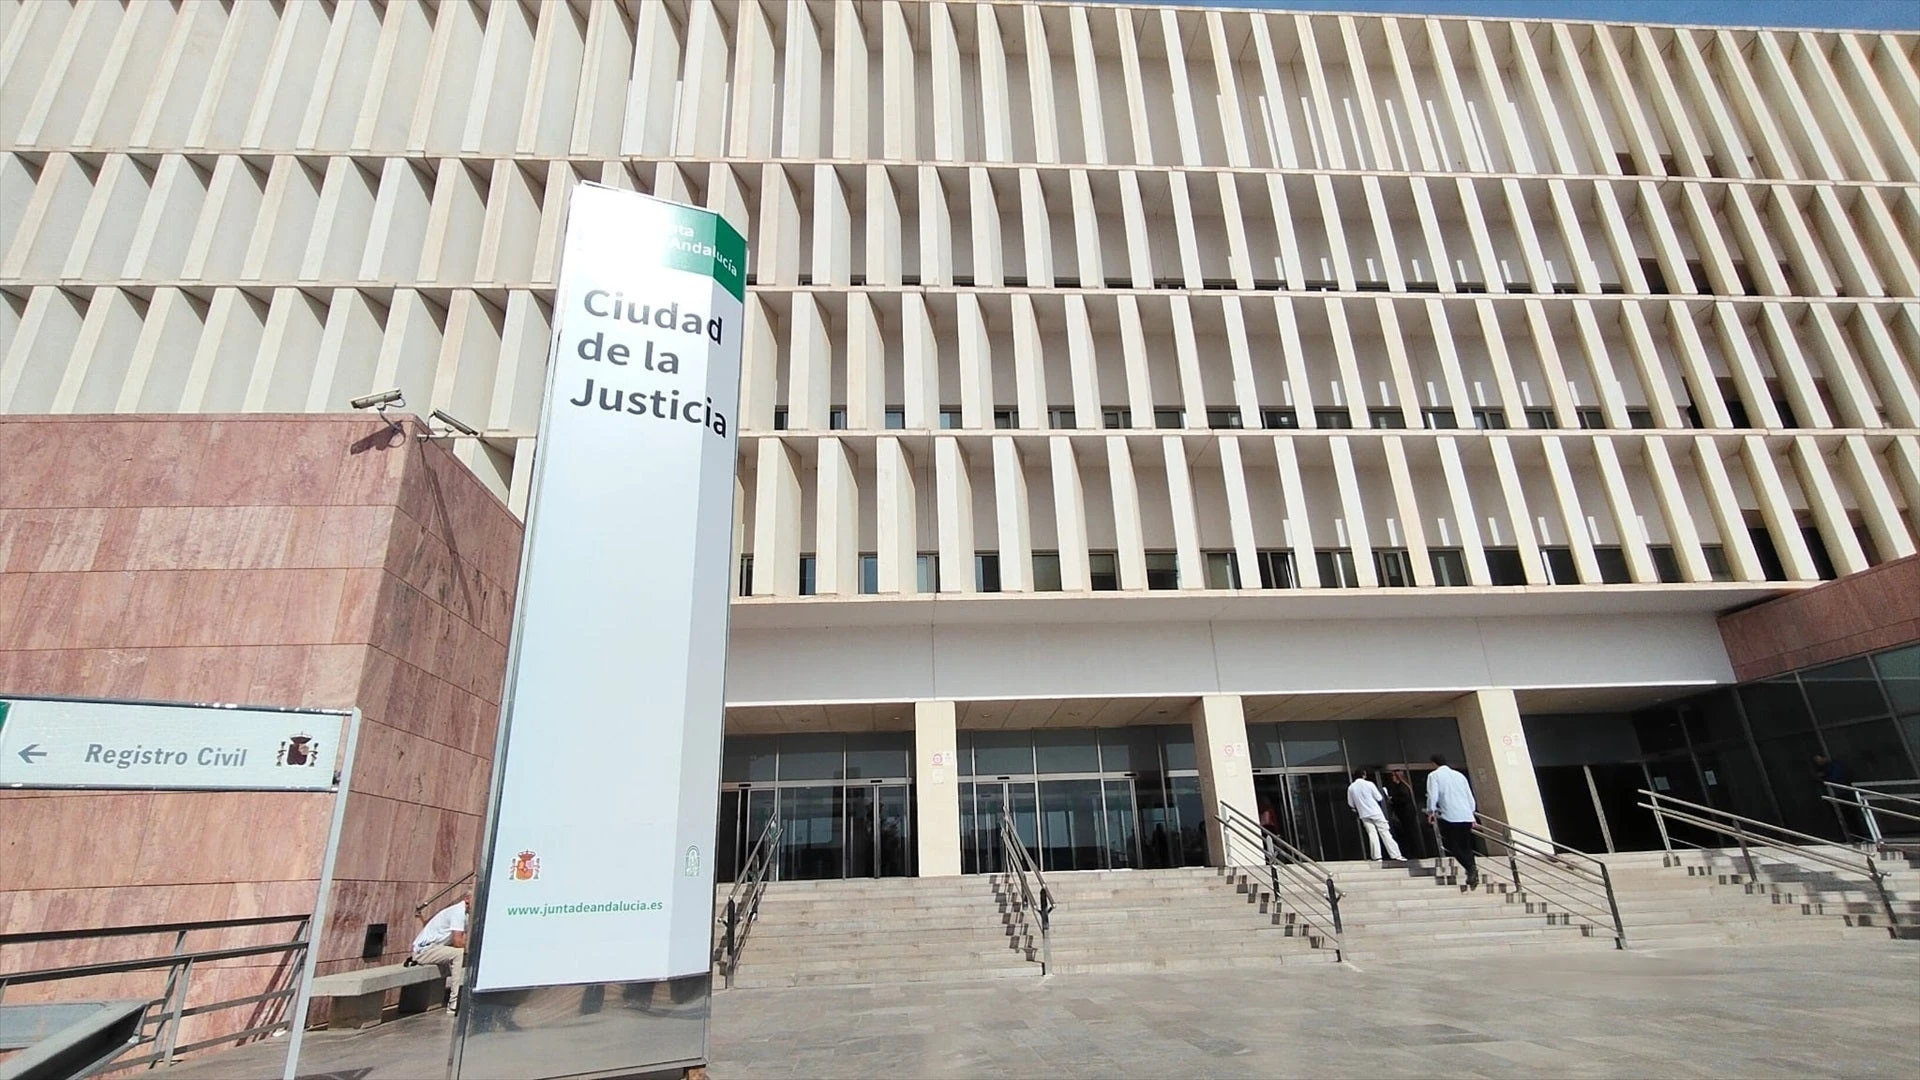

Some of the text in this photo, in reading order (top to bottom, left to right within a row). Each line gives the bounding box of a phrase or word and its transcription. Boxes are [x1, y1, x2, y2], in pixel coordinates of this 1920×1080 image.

[584, 289, 723, 345] Ciudad
[577, 332, 680, 375] de la
[570, 378, 727, 438] Justicia
[85, 743, 248, 769] Registro Civil
[507, 900, 663, 917] www.juntadeandalucia.es
